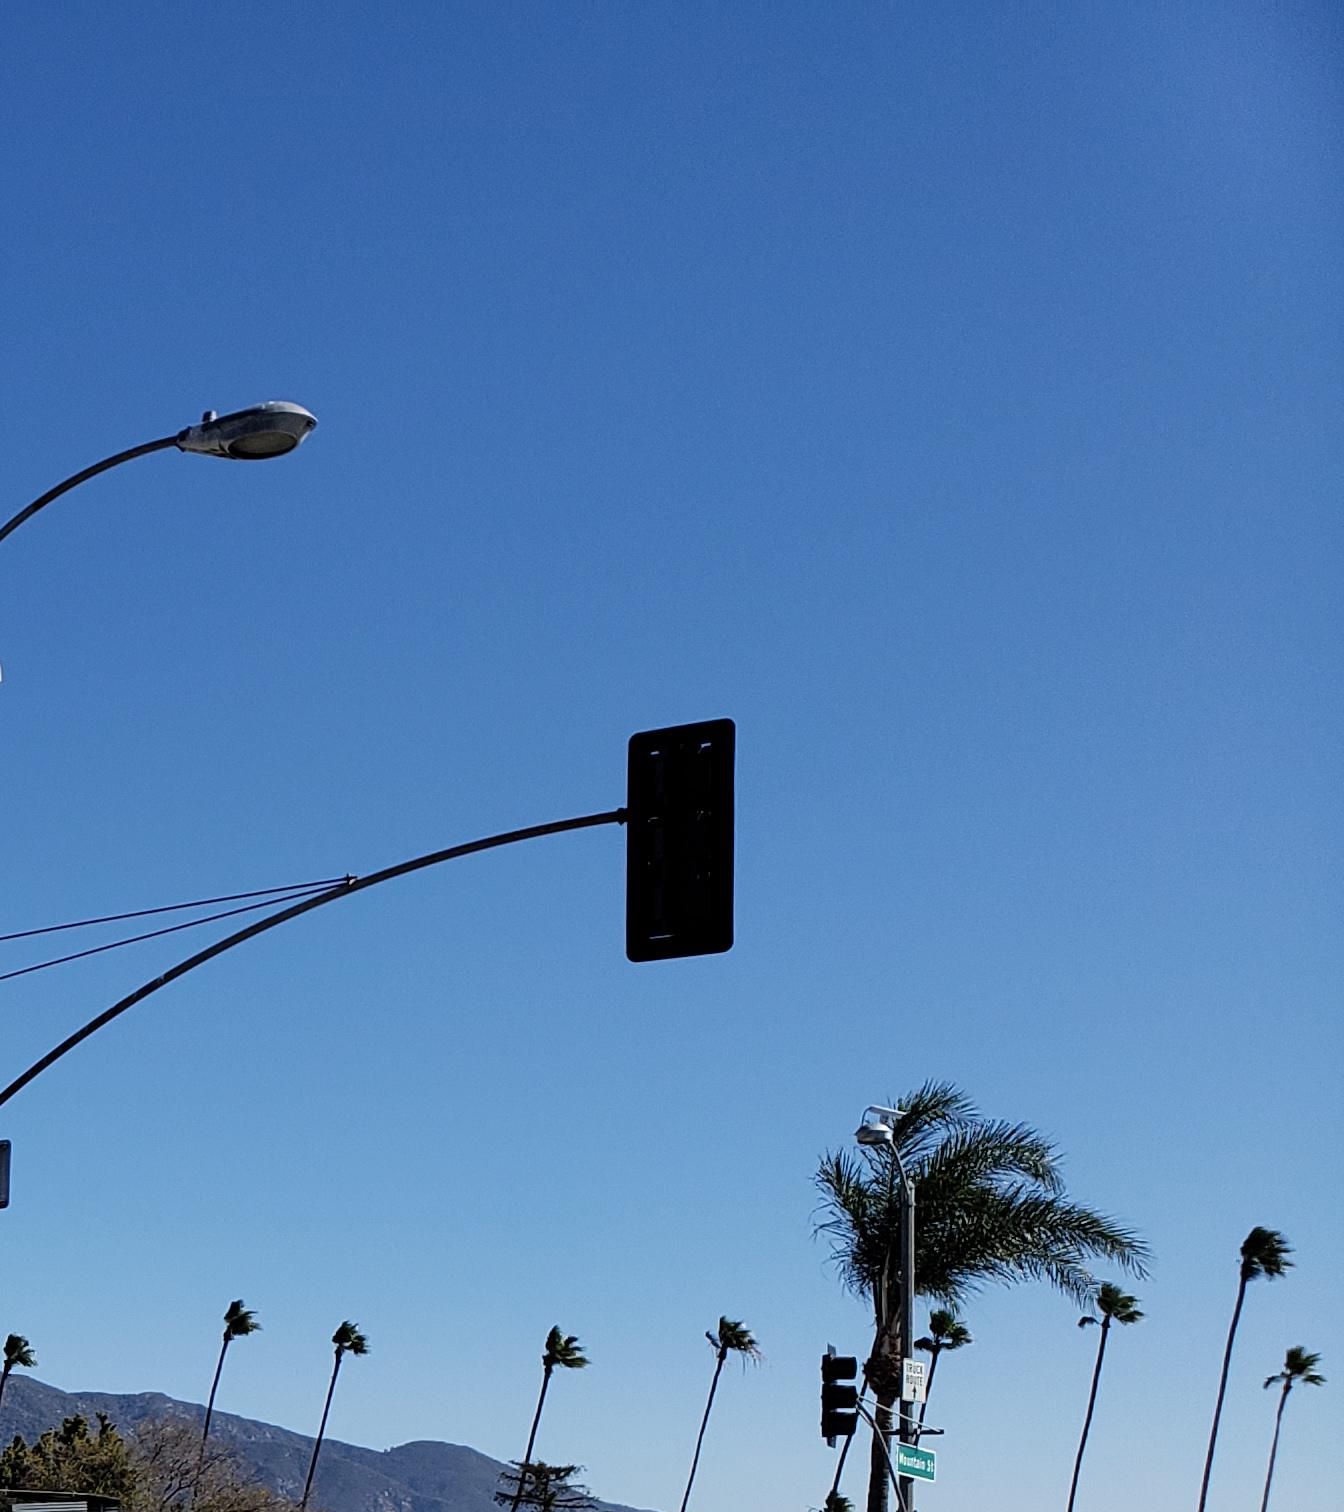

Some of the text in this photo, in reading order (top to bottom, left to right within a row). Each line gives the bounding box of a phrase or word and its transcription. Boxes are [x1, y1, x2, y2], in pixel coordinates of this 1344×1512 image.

[906, 1363, 923, 1375] TRUCK
[906, 1374, 923, 1386] ROUTE
[899, 1452, 934, 1472] Mountain St
